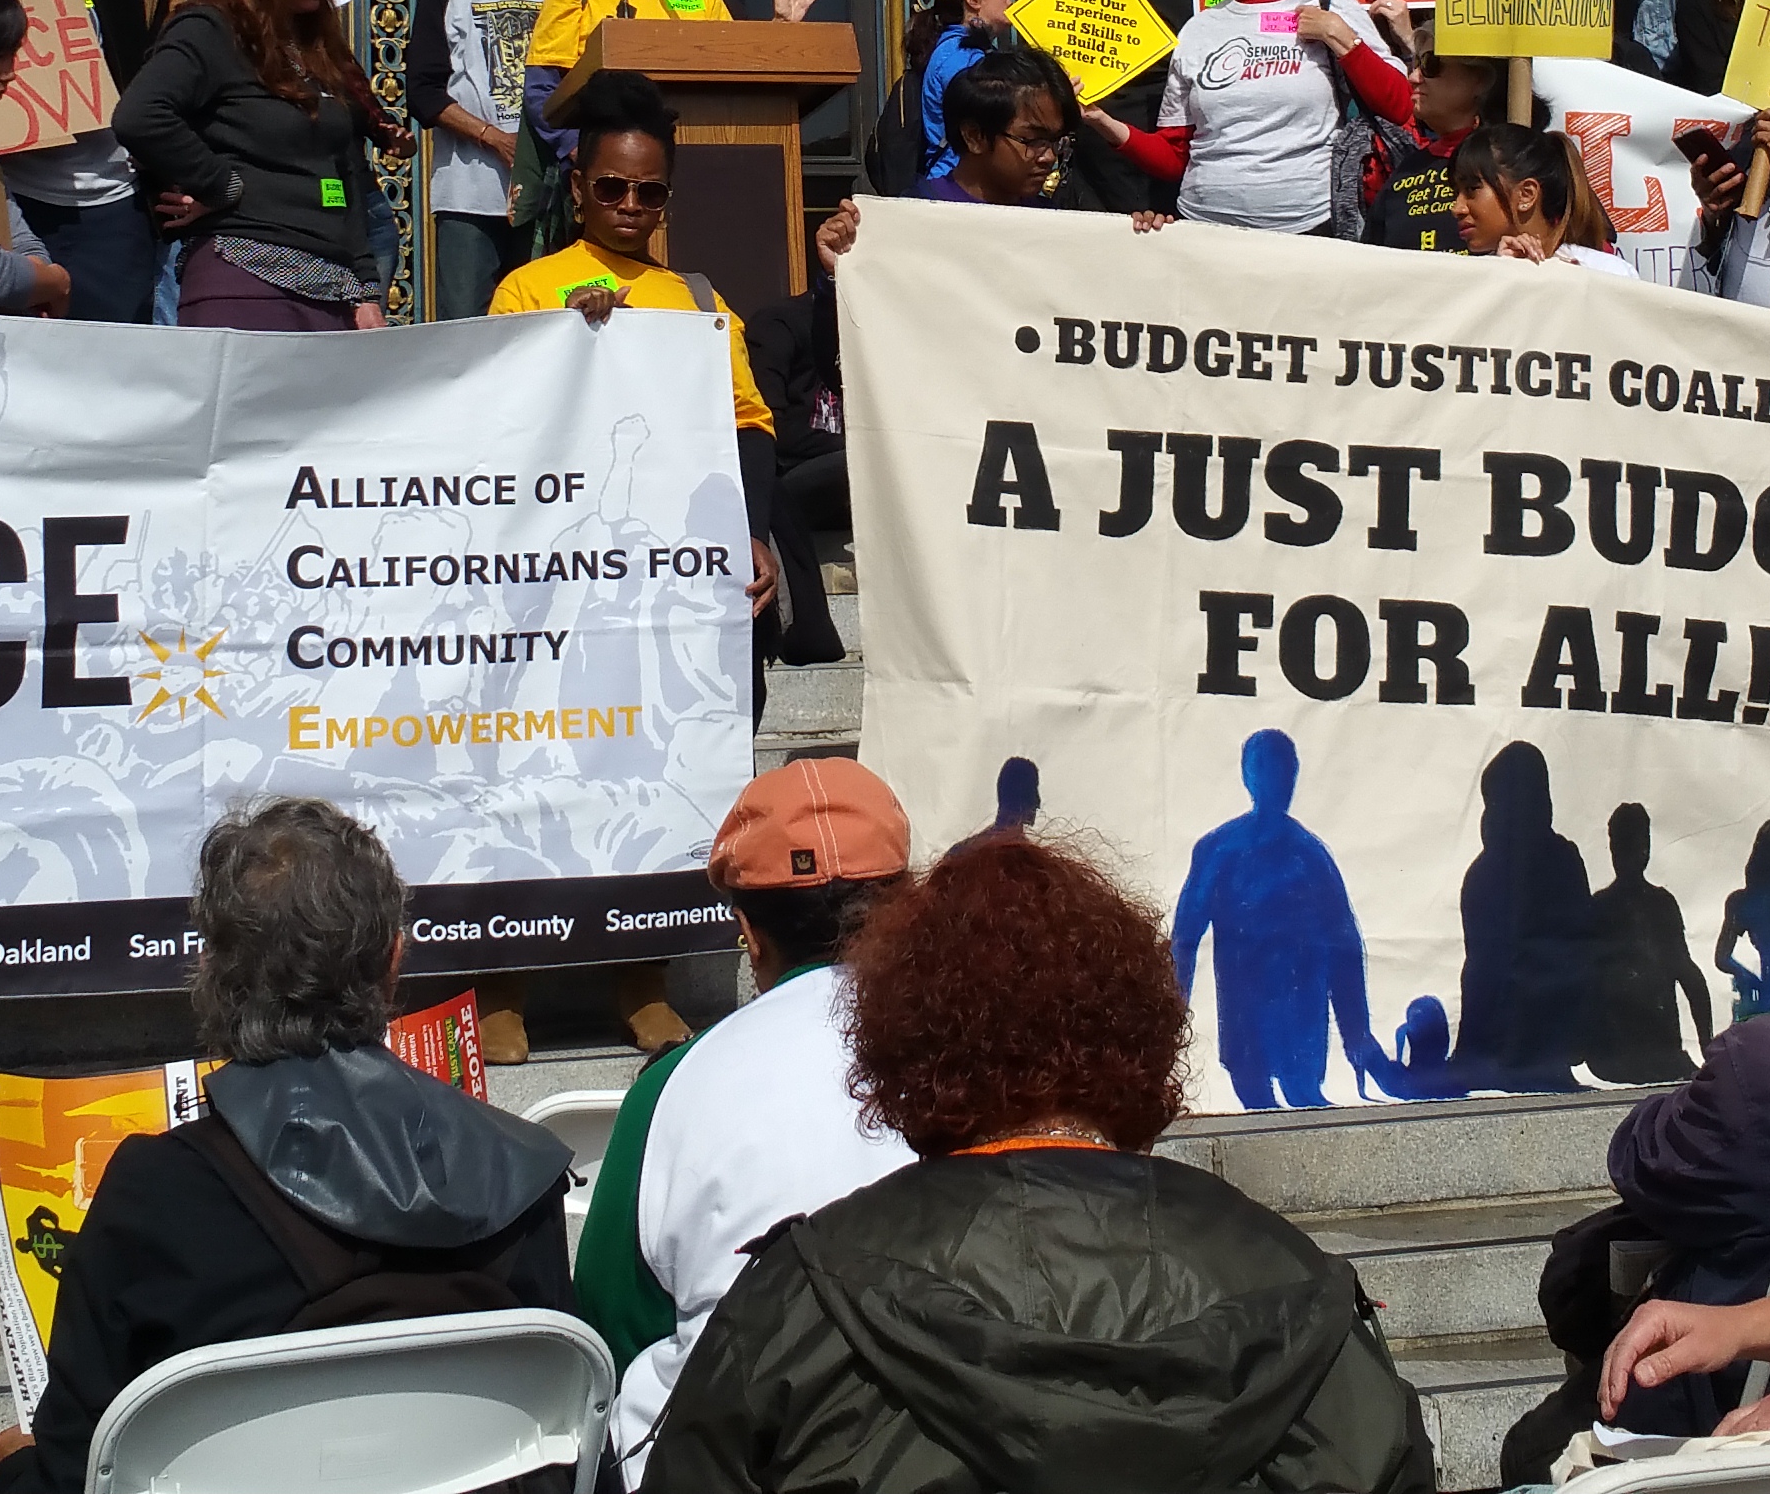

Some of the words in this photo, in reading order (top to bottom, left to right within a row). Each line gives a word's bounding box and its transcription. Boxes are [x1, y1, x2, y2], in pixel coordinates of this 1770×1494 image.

[1054, 0, 1138, 28] Experience
[1047, 19, 1077, 32] and
[1080, 22, 1123, 43] Skills
[1127, 33, 1141, 46] to
[1067, 34, 1106, 53] Build
[1109, 45, 1118, 56] a
[1052, 45, 1096, 65] Better
[1099, 56, 1131, 73] City
[1240, 60, 1302, 81] ACTION
[1407, 187, 1431, 203] Get
[1409, 204, 1430, 216] Get
[1052, 316, 1317, 386] BUDGET
[1334, 338, 1592, 401] JUSTICE
[285, 465, 517, 509] ALLIANCE
[534, 472, 585, 504] OF
[966, 419, 1062, 532] A
[1098, 427, 1442, 552] JUST
[286, 544, 628, 590] CALIFORNIANS
[648, 545, 733, 579] FOR
[286, 625, 570, 669] COMMUNITY
[1197, 589, 1477, 707] FOR
[288, 705, 643, 750] EMPOWERMENT
[412, 918, 482, 943] Costa
[488, 913, 575, 942] County
[129, 934, 176, 958] San
[460, 1004, 483, 1098] EOPLE
[4, 1294, 14, 1308] has
[16, 1298, 29, 1321] being
[10, 1310, 28, 1355] Population
[3, 1325, 30, 1402] HAPPEN
[25, 1358, 36, 1382] Black
[33, 1349, 42, 1366] now
[37, 1368, 47, 1382] but
